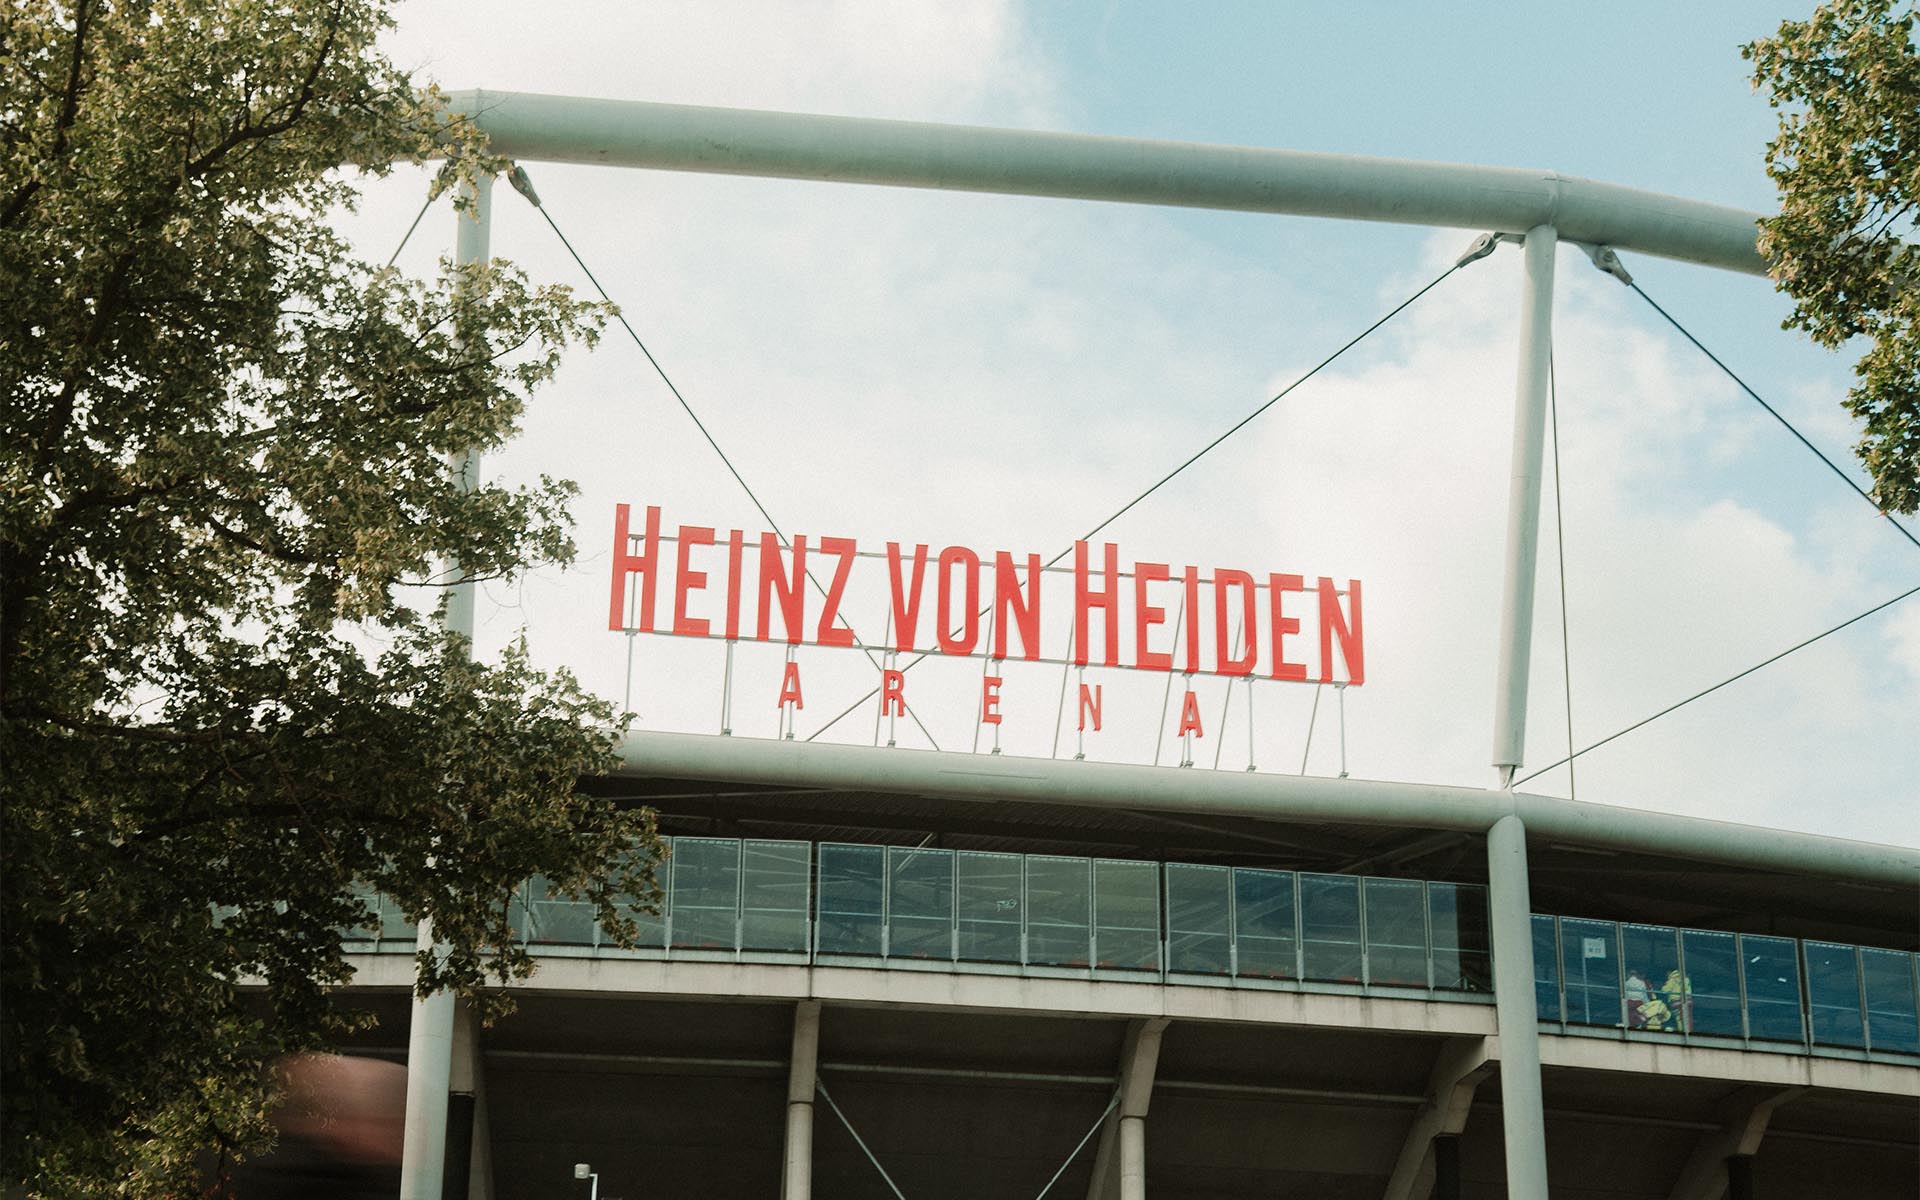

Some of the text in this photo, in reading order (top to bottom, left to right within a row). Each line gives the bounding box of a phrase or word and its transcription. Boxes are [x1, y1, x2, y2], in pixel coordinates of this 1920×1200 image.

[608, 504, 1365, 686] HEINZ VON HEIDEN
[778, 661, 1203, 738] ARENA
